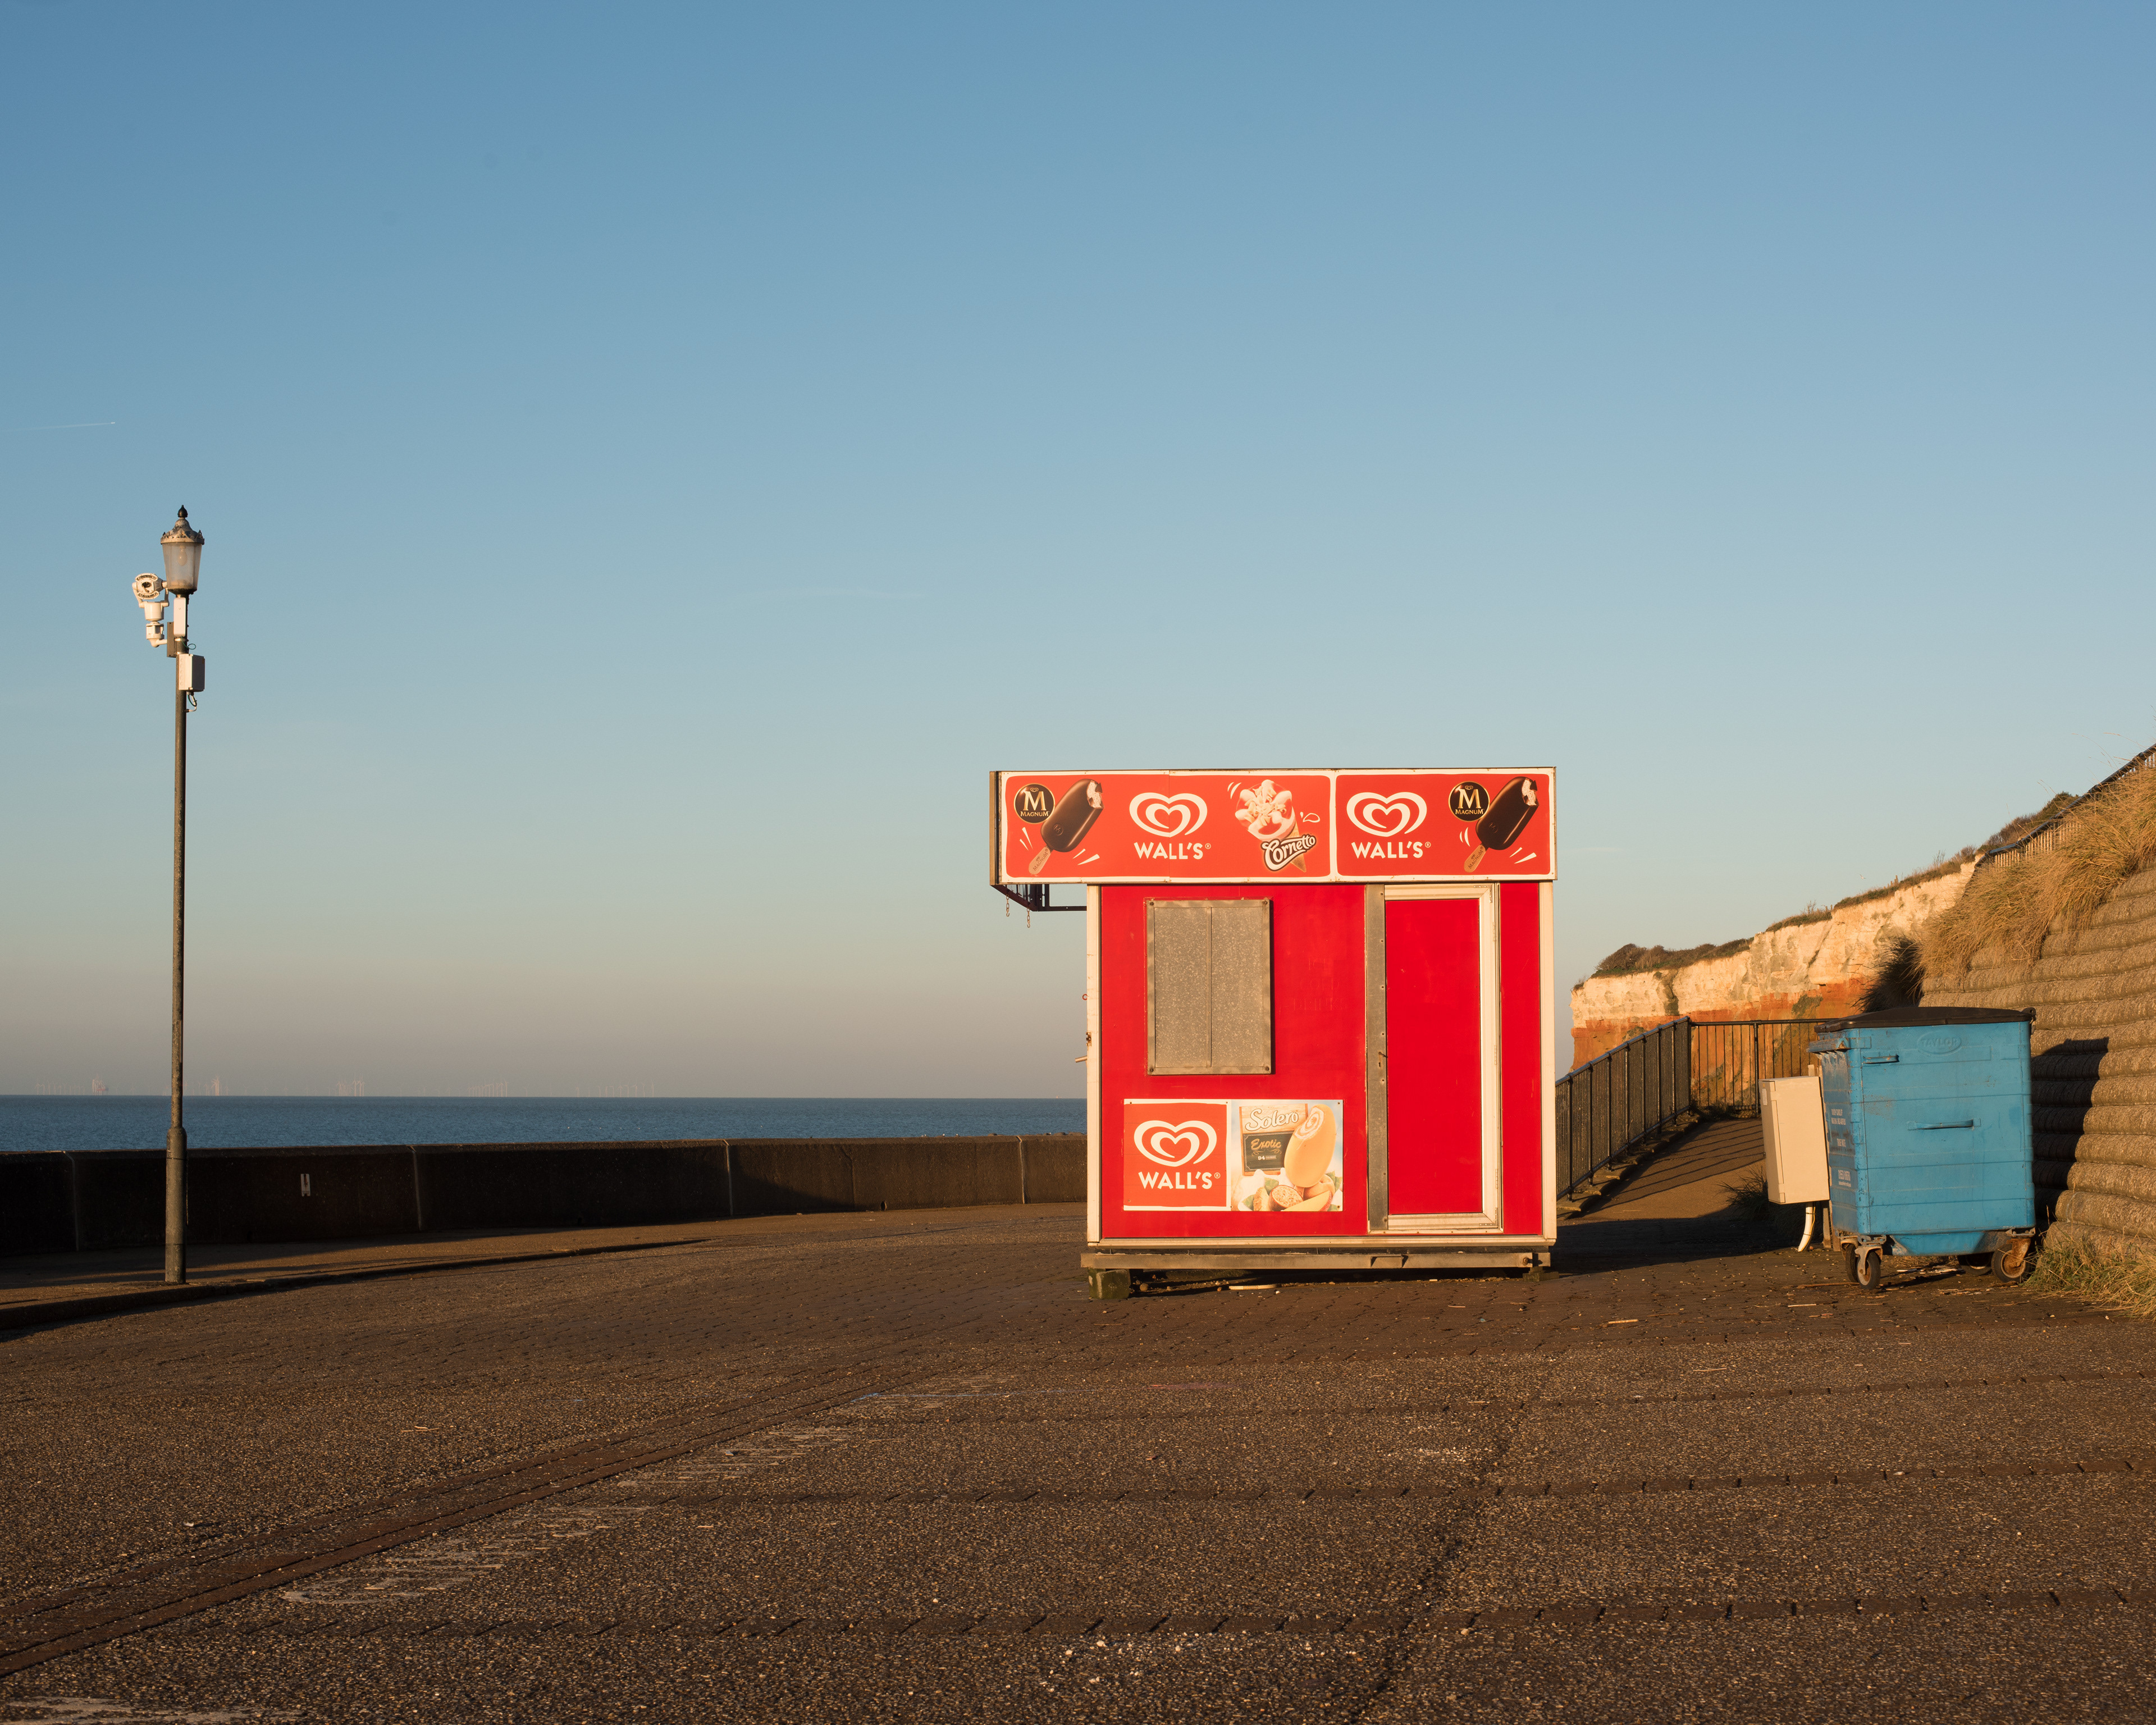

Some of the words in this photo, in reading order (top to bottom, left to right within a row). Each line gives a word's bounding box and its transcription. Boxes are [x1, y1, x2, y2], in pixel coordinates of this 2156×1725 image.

[1023, 791, 1047, 811] M
[1458, 788, 1482, 809] M
[1033, 851, 1048, 871] MAGNUM
[1261, 834, 1315, 870] Cornetto
[1468, 850, 1484, 869] MAGNUM
[1920, 1037, 1959, 1047] TAYLOR
[1245, 1108, 1299, 1131] Solero
[1251, 1138, 1282, 1151] Exotic
